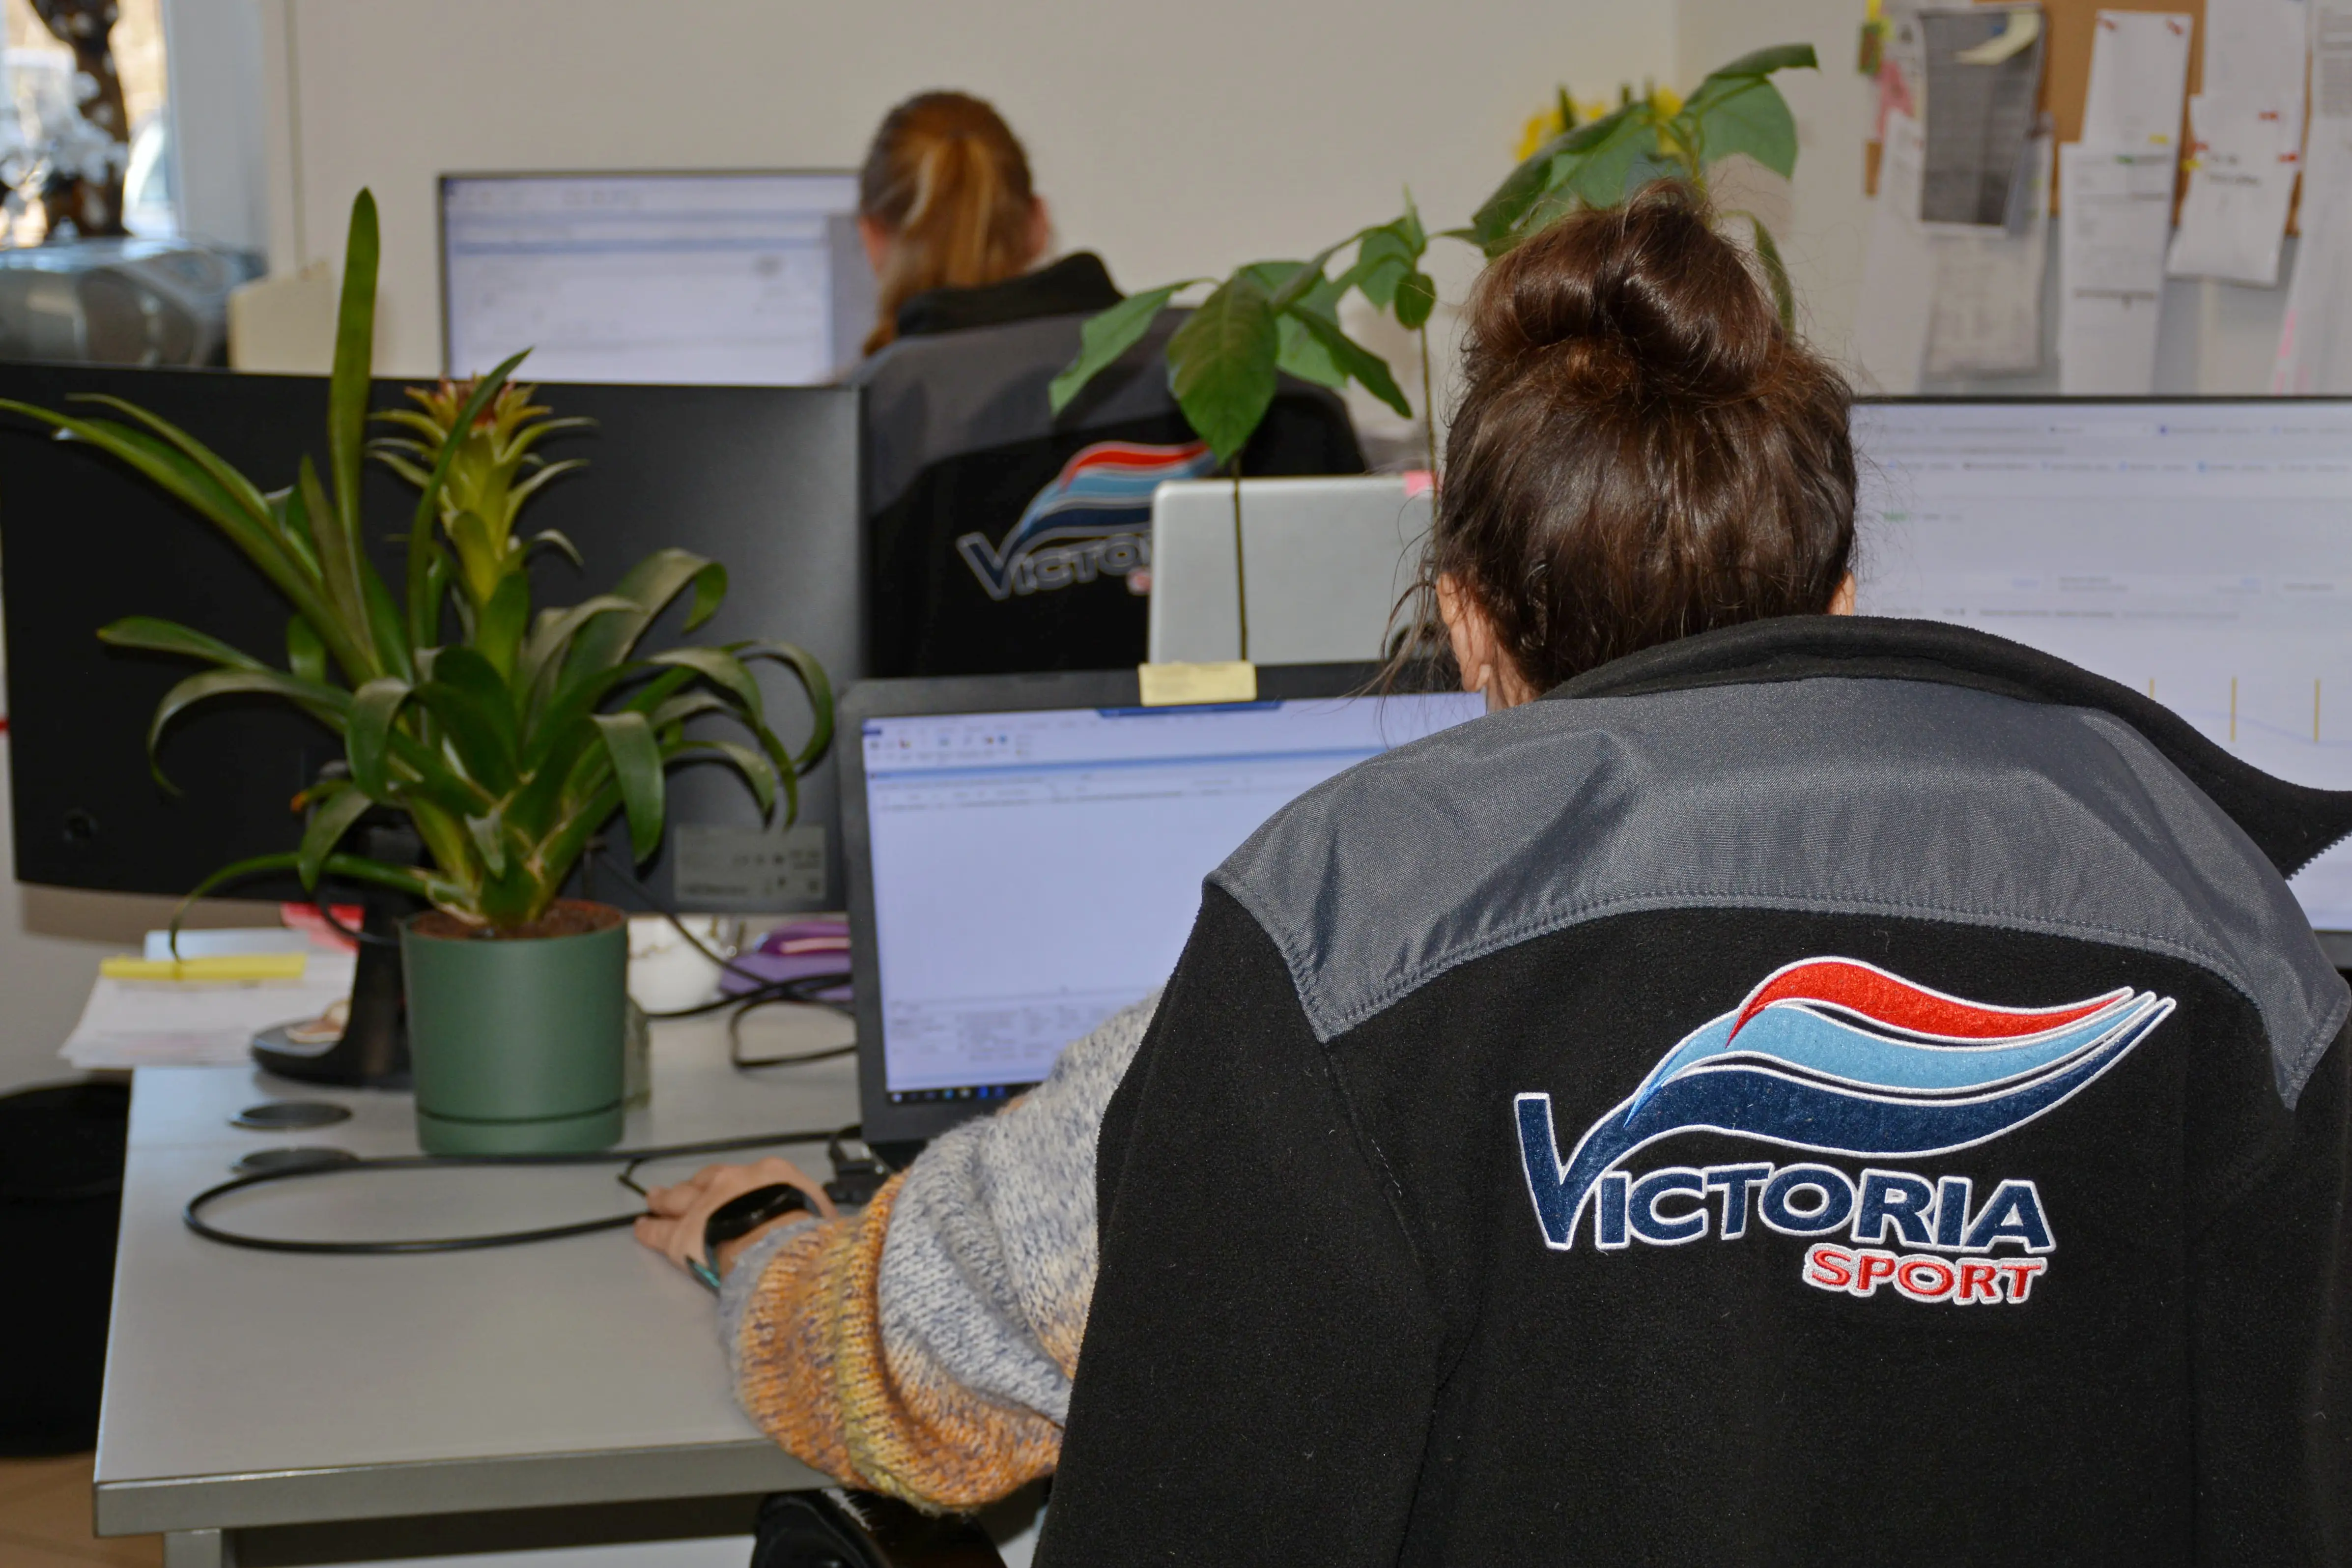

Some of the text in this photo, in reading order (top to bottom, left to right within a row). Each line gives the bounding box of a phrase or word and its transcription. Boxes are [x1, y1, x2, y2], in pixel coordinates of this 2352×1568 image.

[956, 533, 1152, 600] VICTO
[1514, 1092, 2056, 1252] VICTORIA
[1804, 1243, 2048, 1304] SPORT
